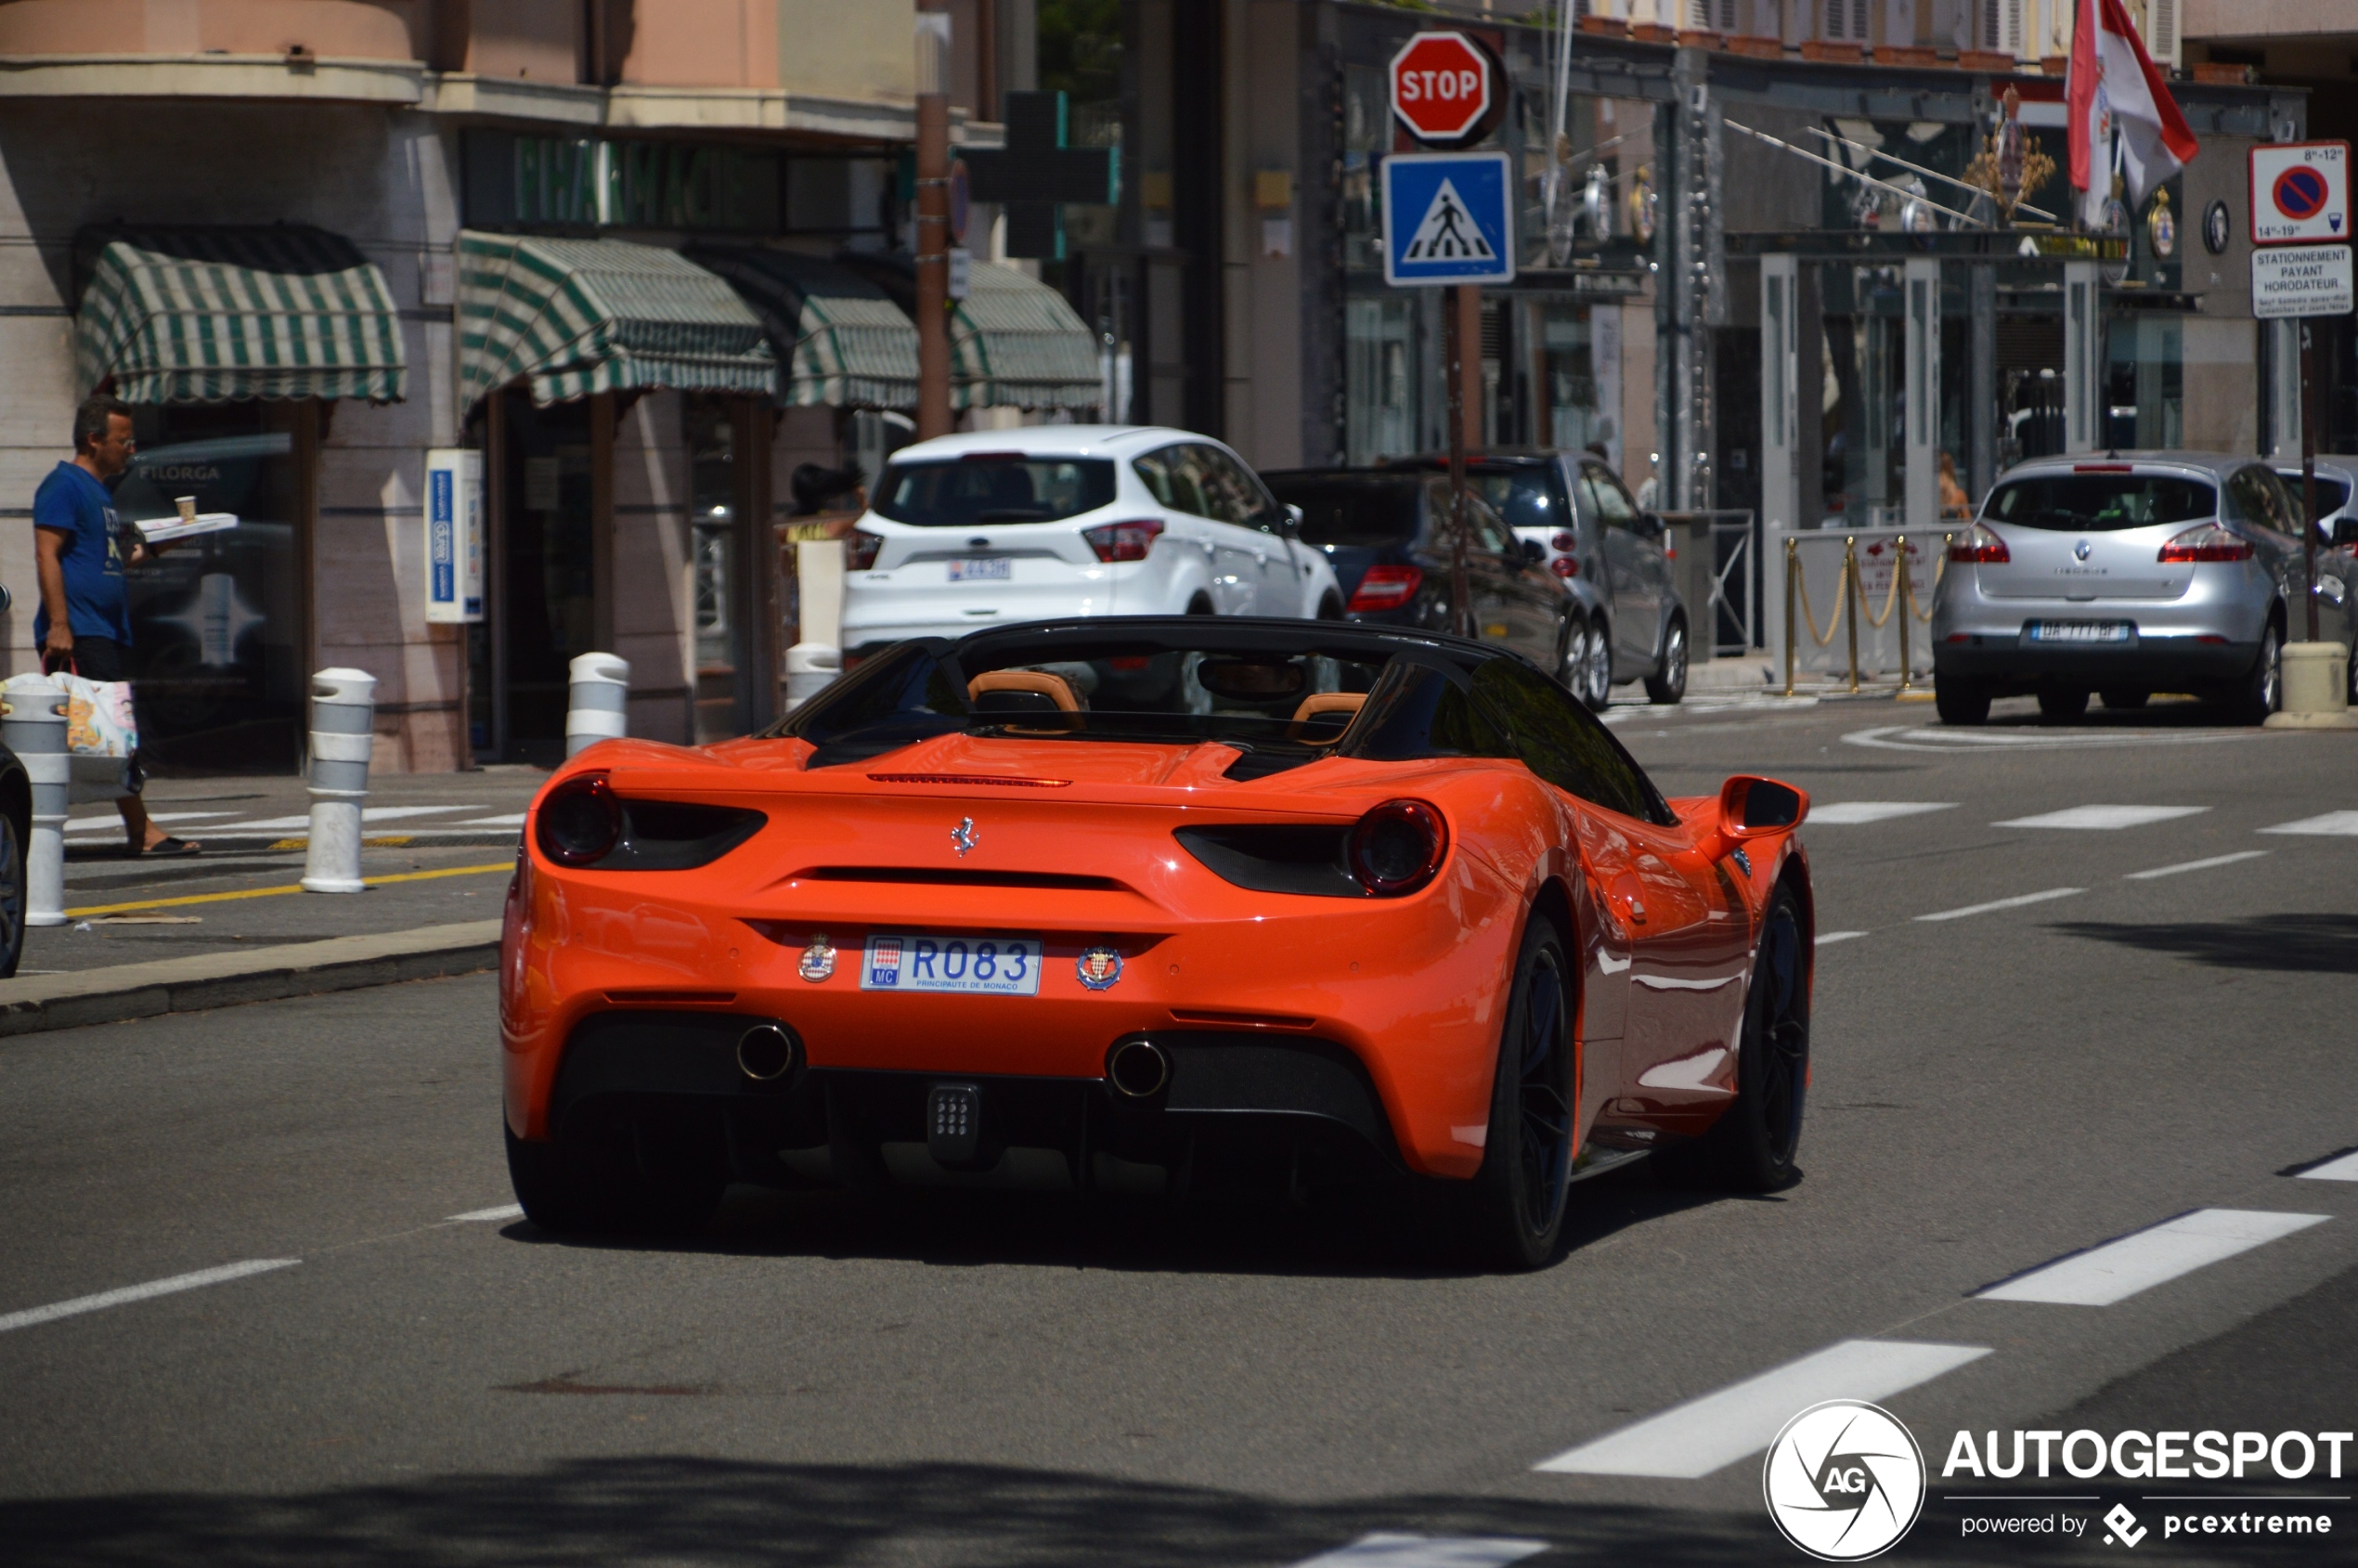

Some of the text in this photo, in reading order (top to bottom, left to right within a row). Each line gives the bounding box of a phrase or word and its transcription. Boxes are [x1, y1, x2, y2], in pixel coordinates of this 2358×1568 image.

[1402, 71, 1478, 101] STOP
[2258, 250, 2346, 265] STATIONNEMENT
[2281, 265, 2323, 277] PAYANT
[2265, 279, 2338, 292] HORODATEUR
[140, 466, 219, 480] FILORGA
[435, 524, 449, 560] durex
[875, 940, 1028, 983] MC R083
[916, 979, 967, 989] PRINCIPAUTE
[983, 982, 1017, 991] MONACO
